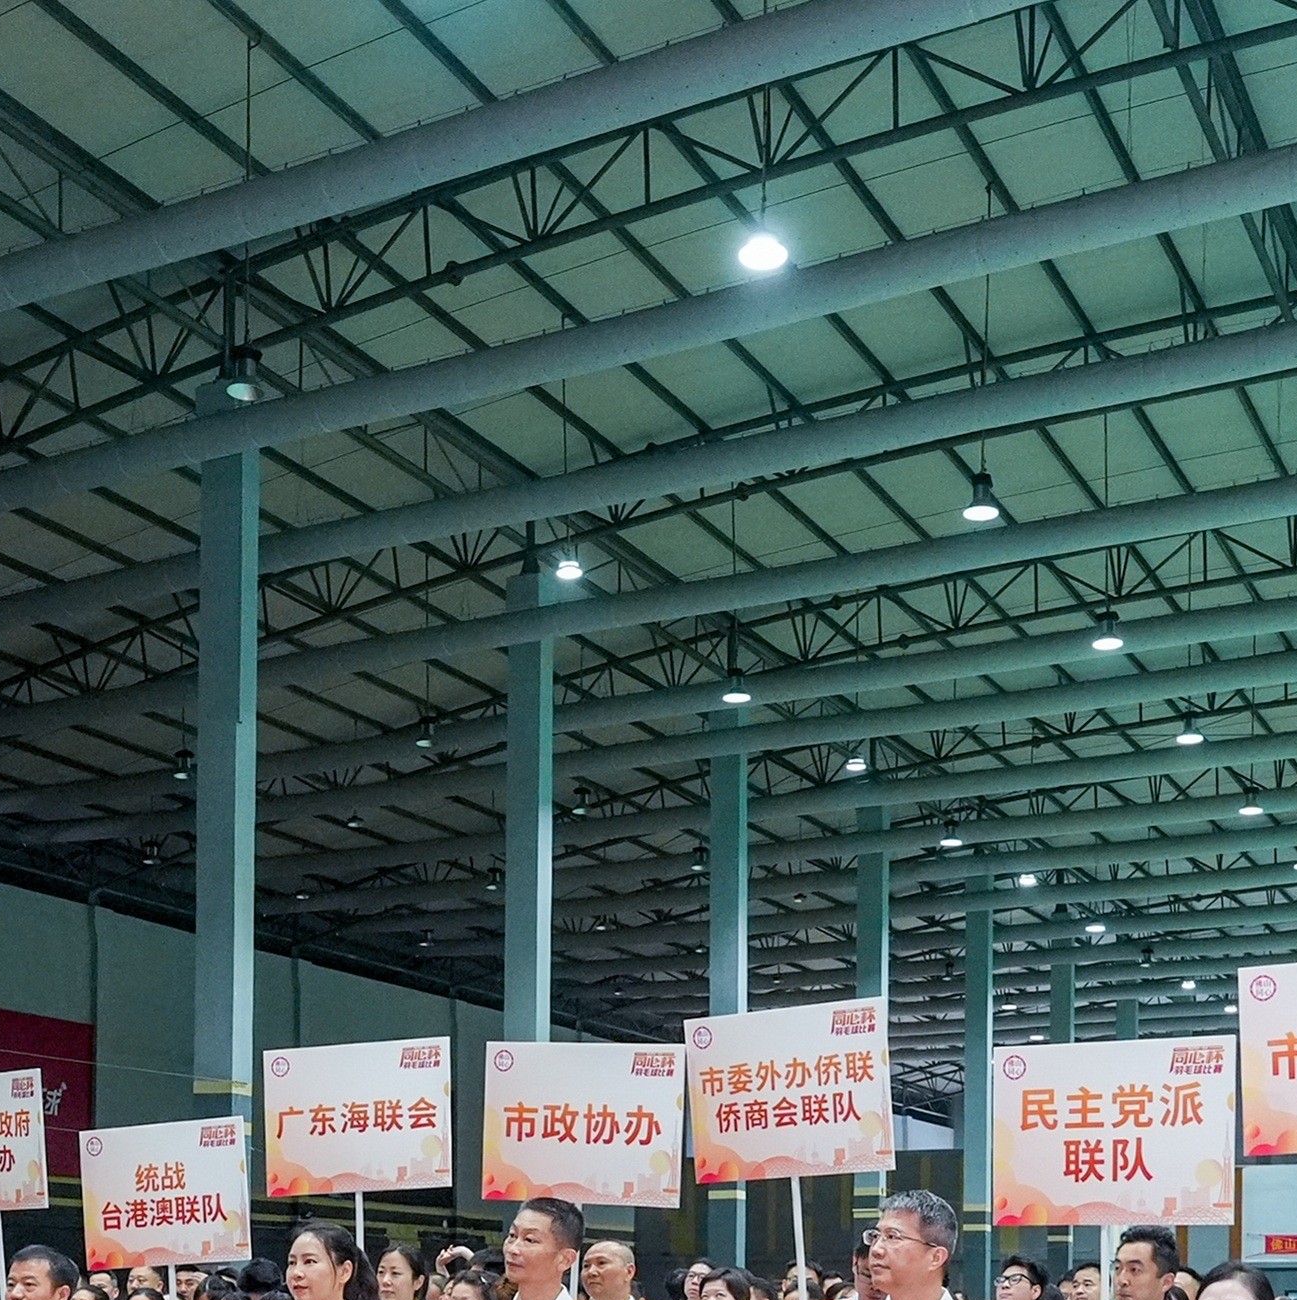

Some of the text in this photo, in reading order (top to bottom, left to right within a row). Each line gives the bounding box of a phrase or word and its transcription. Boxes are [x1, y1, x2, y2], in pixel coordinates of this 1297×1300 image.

[699, 1051, 875, 1097] 市委外办侨联
[276, 1097, 437, 1139] 广东海联会
[504, 1101, 661, 1146] 市政协办
[715, 1090, 861, 1134] 侨商会联队
[1020, 1081, 1204, 1131] 民主党派
[135, 1161, 186, 1193] 统战
[1063, 1137, 1153, 1183] 联队
[101, 1193, 228, 1231] 台港澳联队
